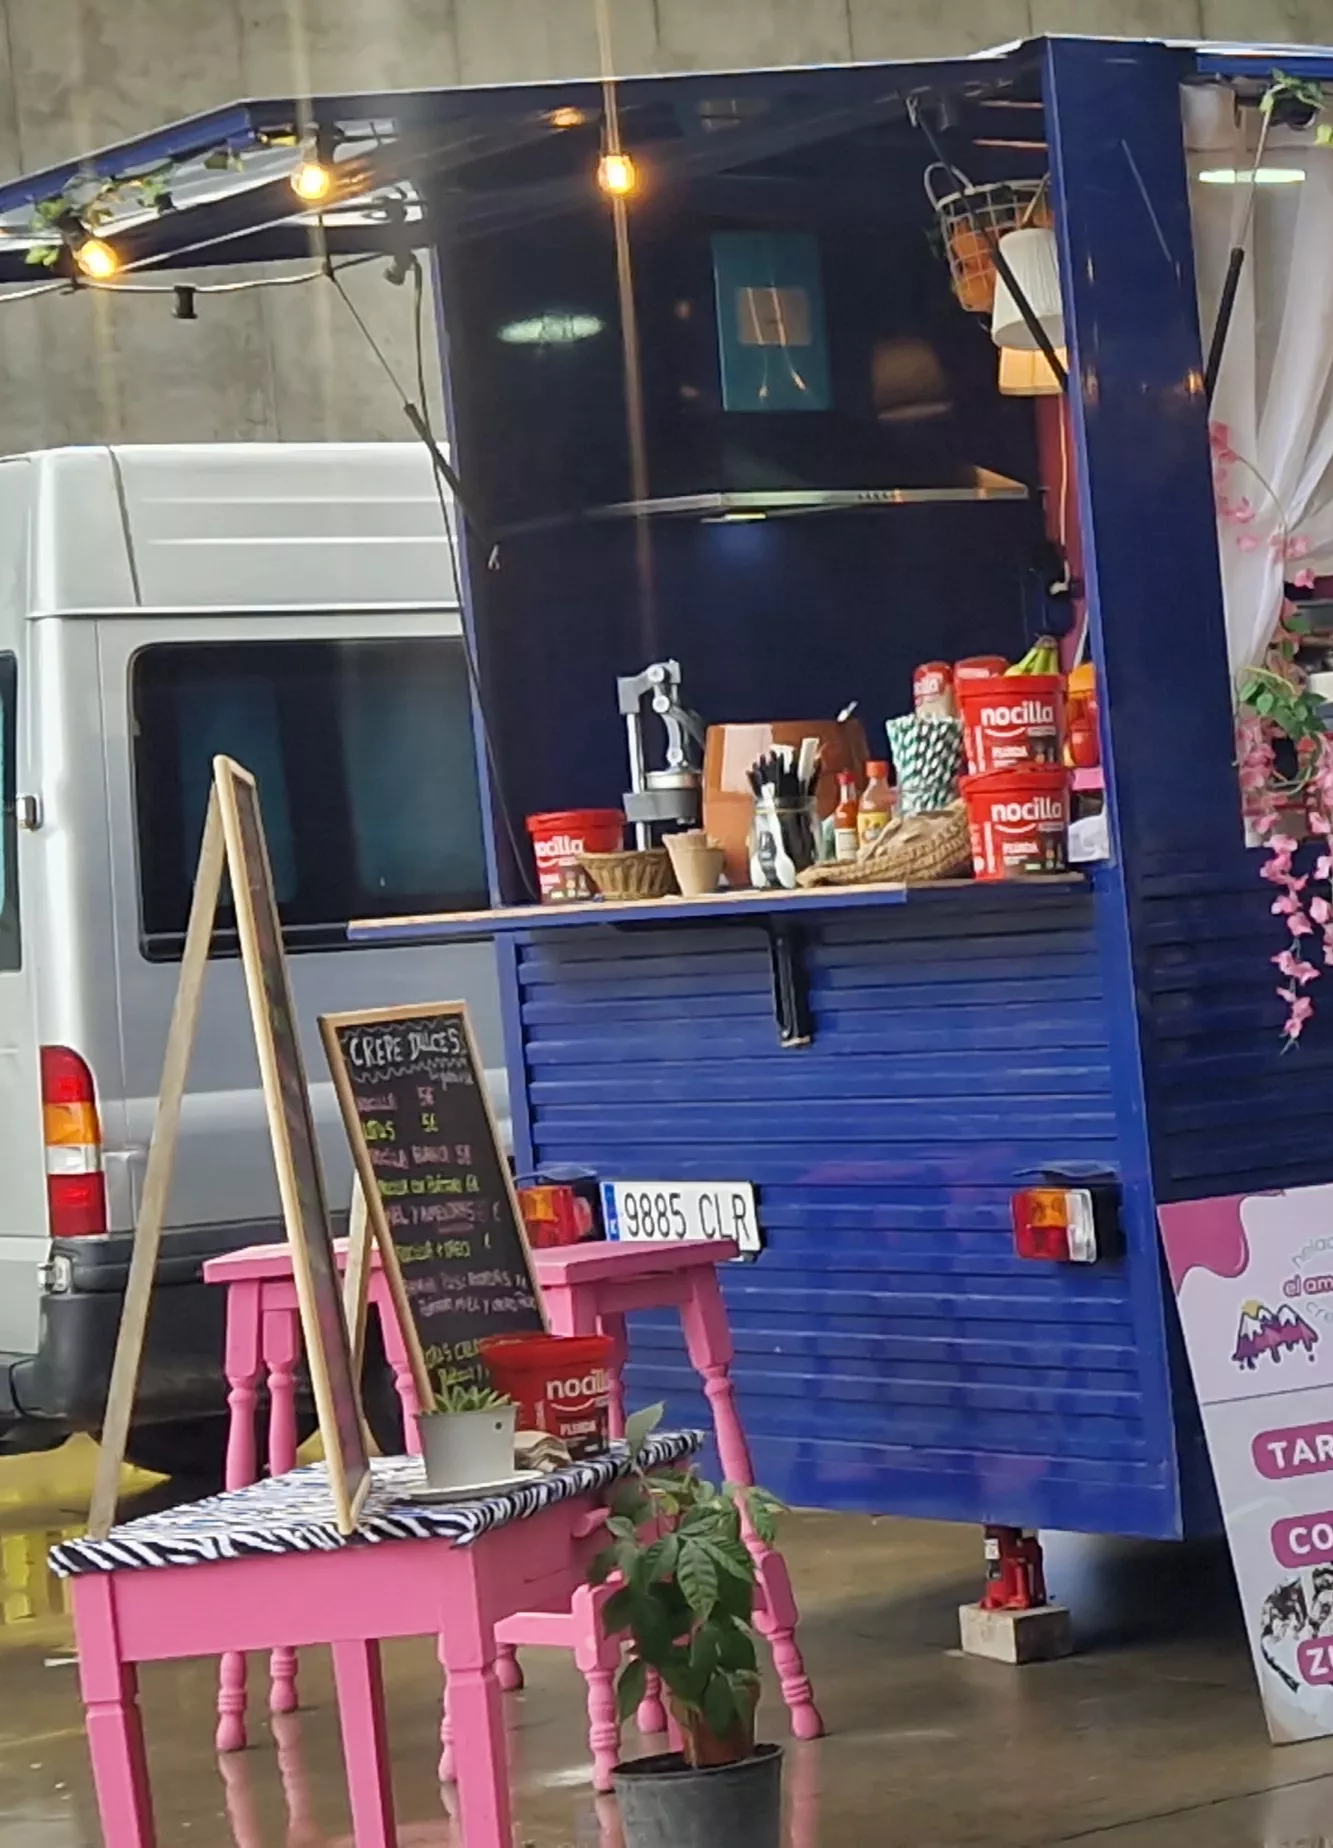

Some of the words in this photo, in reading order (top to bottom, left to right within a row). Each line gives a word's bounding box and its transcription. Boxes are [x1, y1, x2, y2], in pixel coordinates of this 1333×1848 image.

[980, 700, 1053, 727] nocilla
[990, 796, 1062, 822] nocilla
[534, 835, 585, 857] ocilla
[349, 1034, 404, 1068] CREPE
[624, 1192, 687, 1239] 9885
[698, 1192, 751, 1242] CLR
[1283, 1273, 1302, 1298] el
